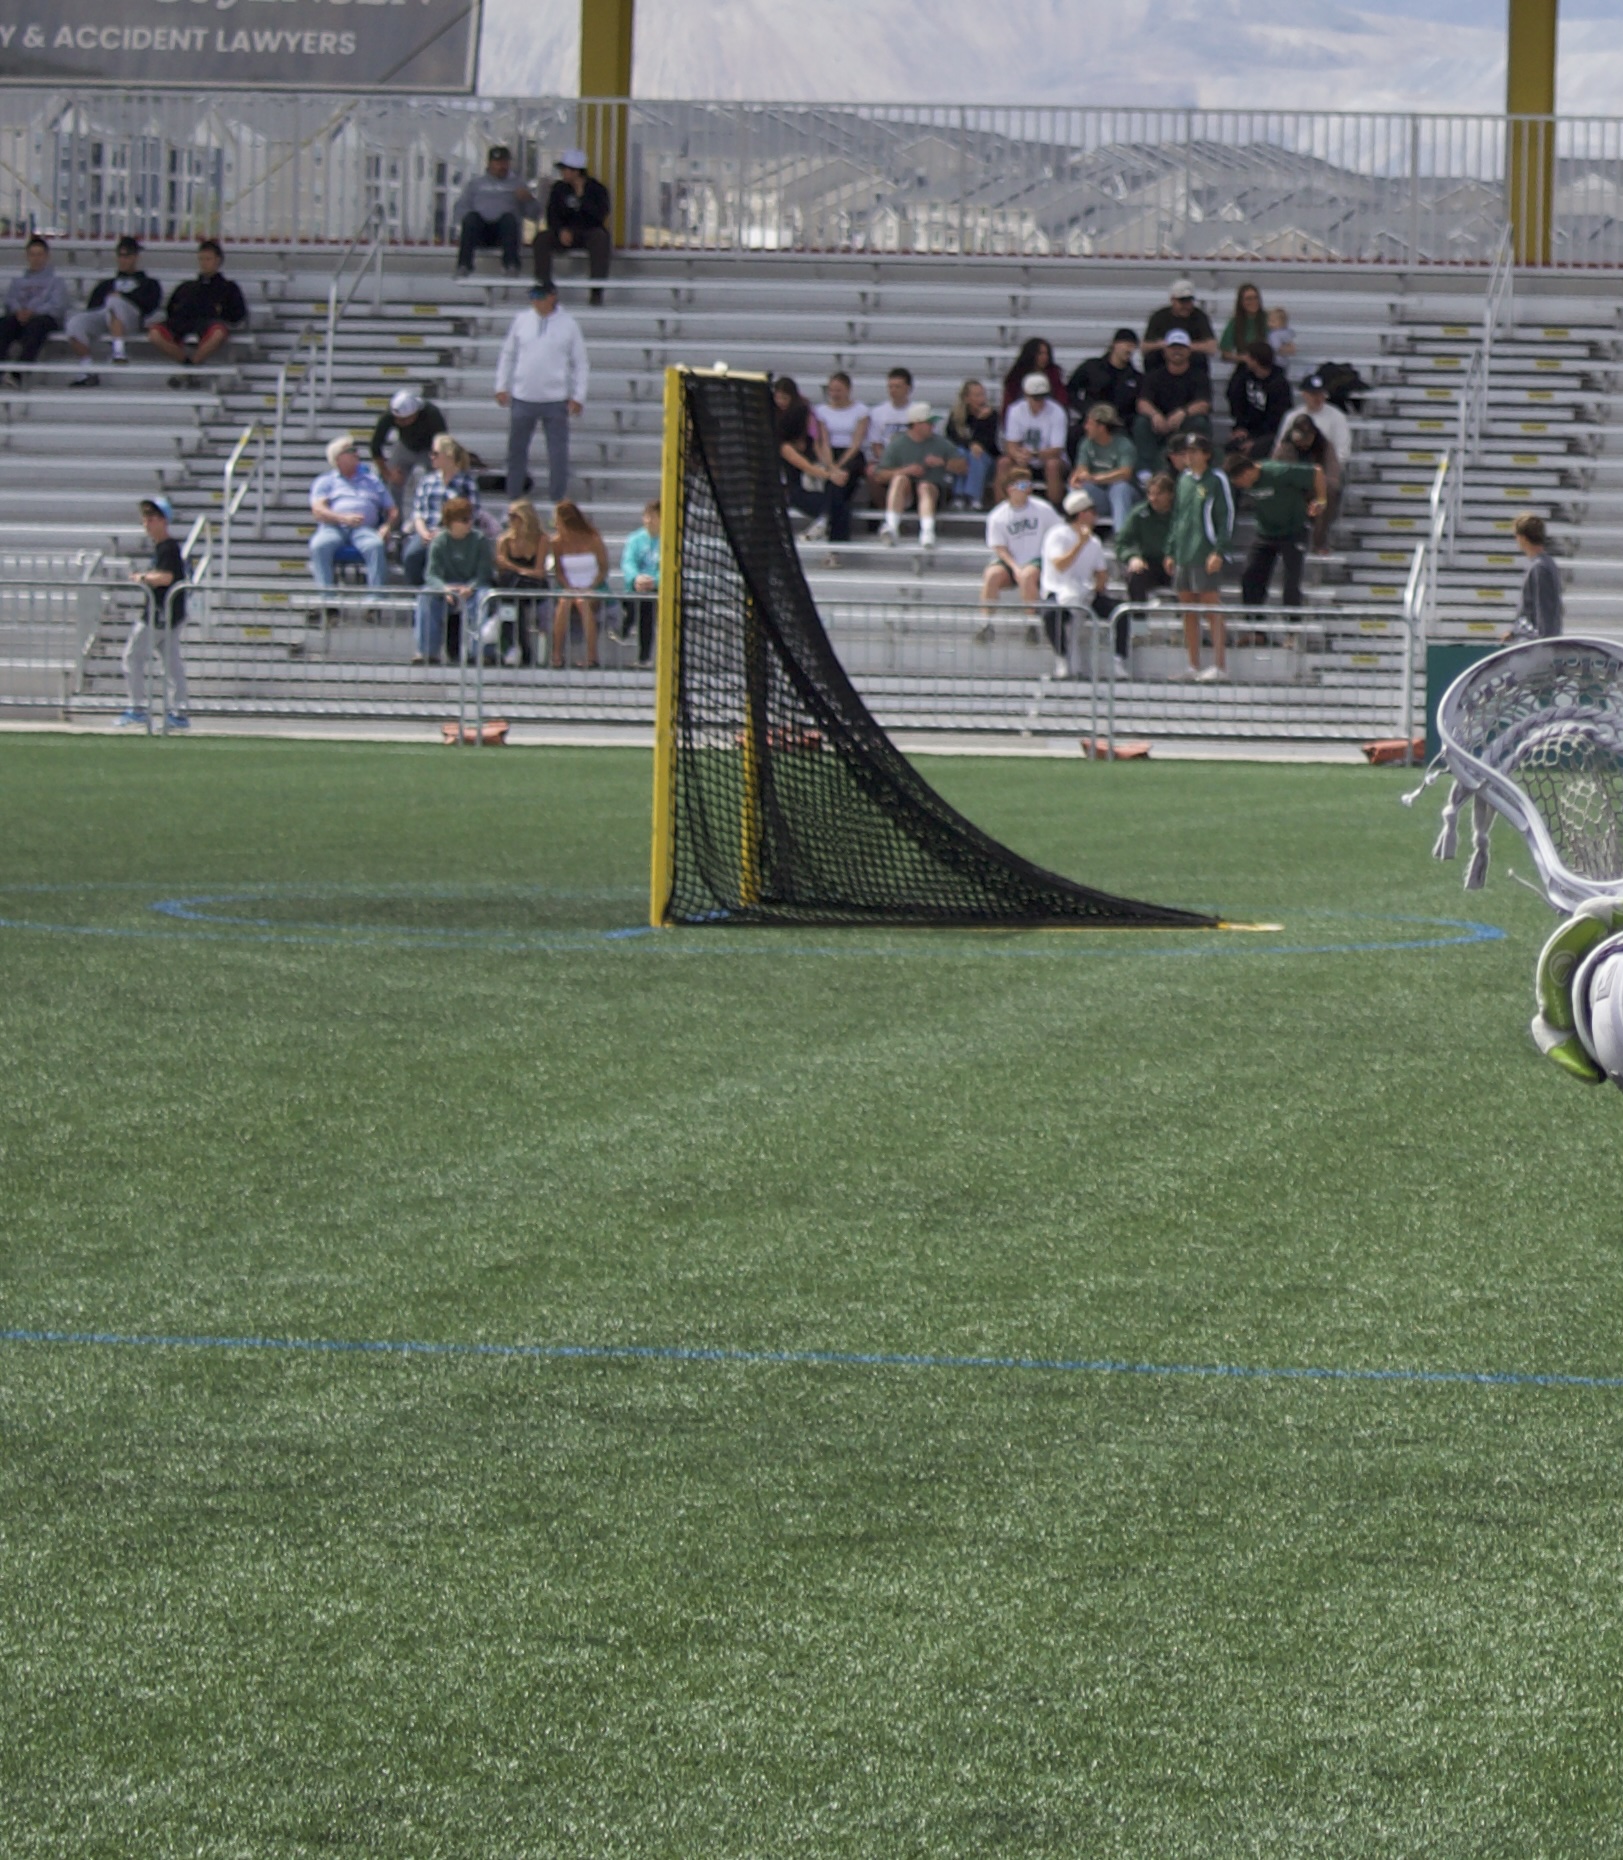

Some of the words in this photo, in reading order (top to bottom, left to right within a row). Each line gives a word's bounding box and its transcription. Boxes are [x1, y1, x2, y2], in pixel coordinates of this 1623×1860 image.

[22, 25, 46, 48] &
[53, 25, 209, 51] ACCIDENT
[216, 29, 356, 55] LAWYERS
